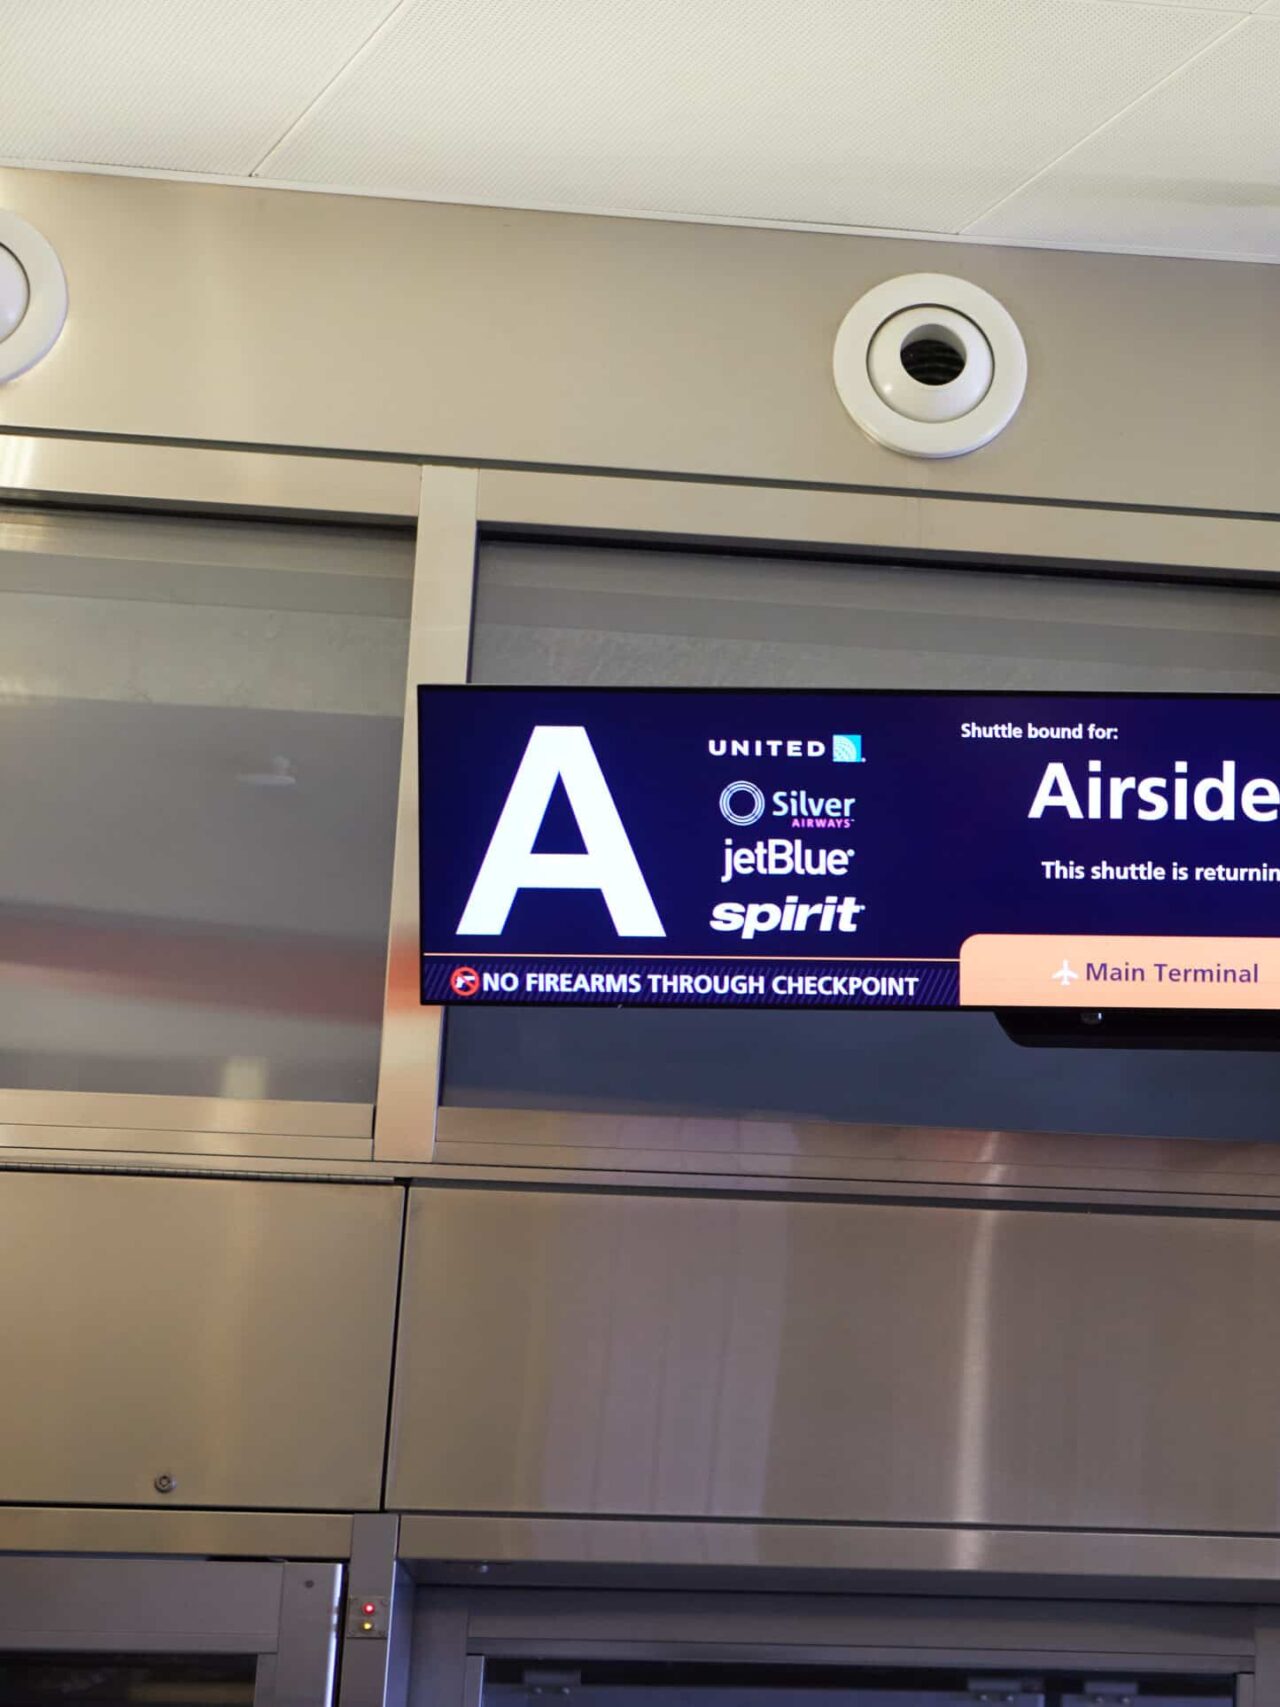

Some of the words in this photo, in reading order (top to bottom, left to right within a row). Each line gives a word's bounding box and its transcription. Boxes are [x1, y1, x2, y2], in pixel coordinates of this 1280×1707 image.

[960, 721, 1023, 739] Shuttle
[1027, 722, 1083, 740] bound
[1087, 723, 1119, 740] for:
[708, 739, 826, 757] UNITED
[1027, 759, 1280, 822] Airside
[772, 790, 856, 817] Silver
[455, 725, 667, 938] A
[791, 818, 852, 829] AIRWAYS
[720, 838, 850, 883] jetBlue
[1041, 859, 1086, 879] This
[1090, 859, 1166, 881] shuttle
[1172, 861, 1189, 881] is
[709, 895, 859, 940] spirit
[483, 972, 519, 992] NO
[526, 973, 642, 993] FIREARMS
[647, 974, 765, 994] THROUGH
[771, 975, 919, 996] CHECKPOINT
[1086, 962, 1145, 982] Main
[1153, 963, 1258, 983] Terminal
